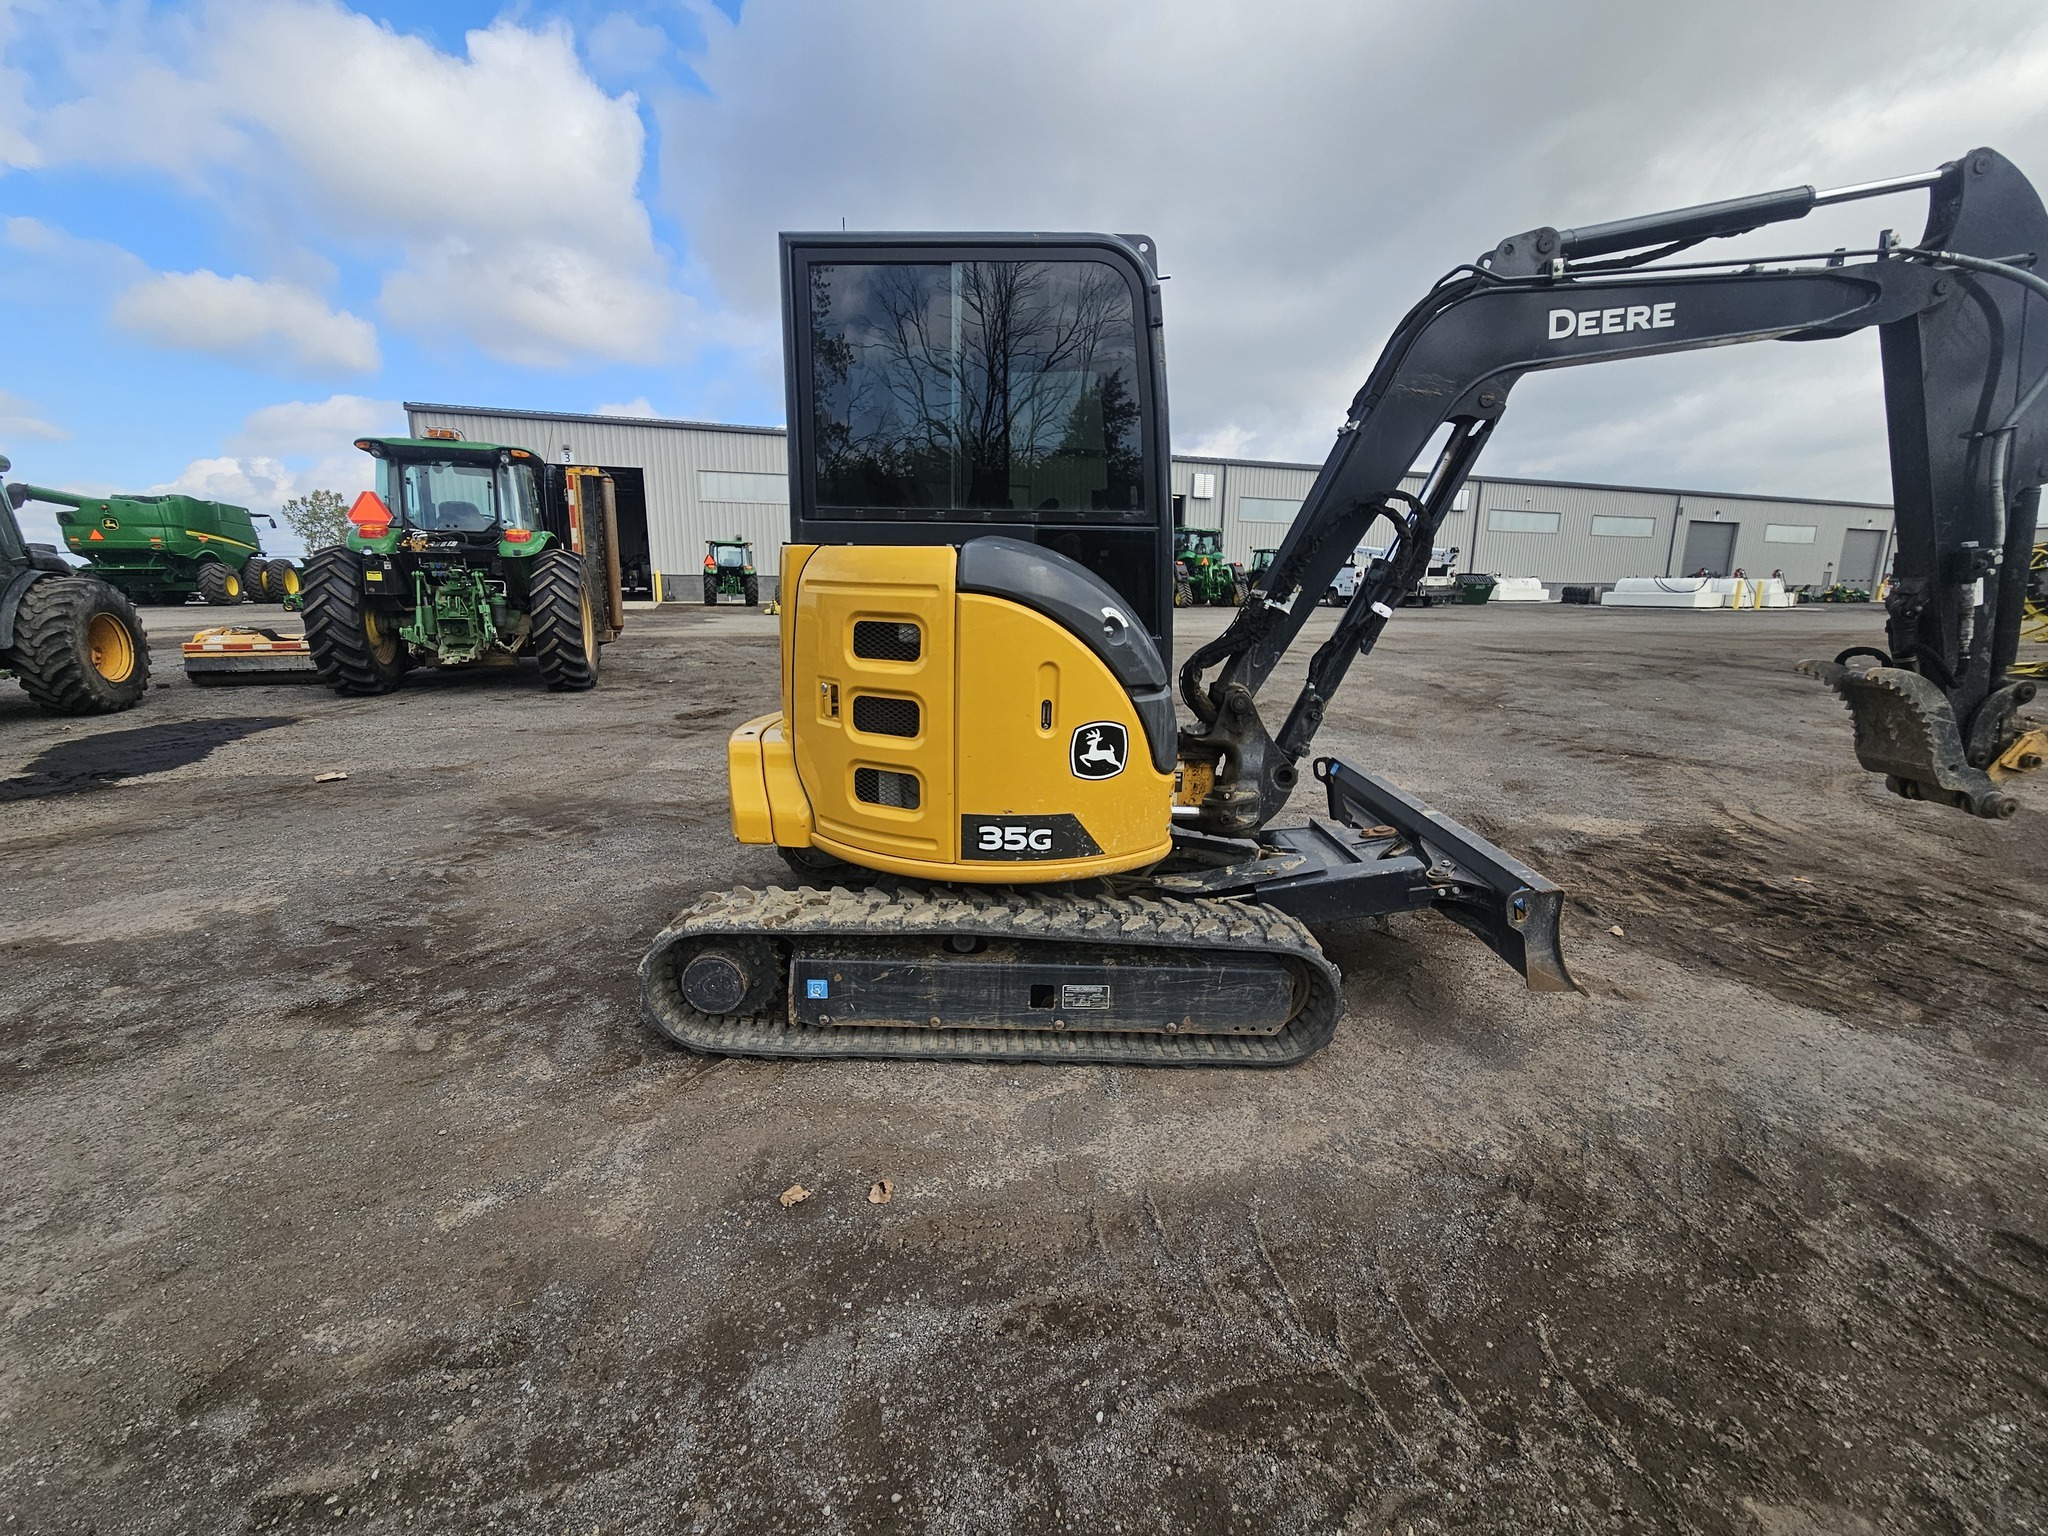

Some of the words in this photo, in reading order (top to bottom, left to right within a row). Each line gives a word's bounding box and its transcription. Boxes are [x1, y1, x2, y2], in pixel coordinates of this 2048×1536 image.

[1548, 302, 1677, 340] DEERE
[564, 453, 571, 463] 3
[978, 825, 1053, 851] 35G
